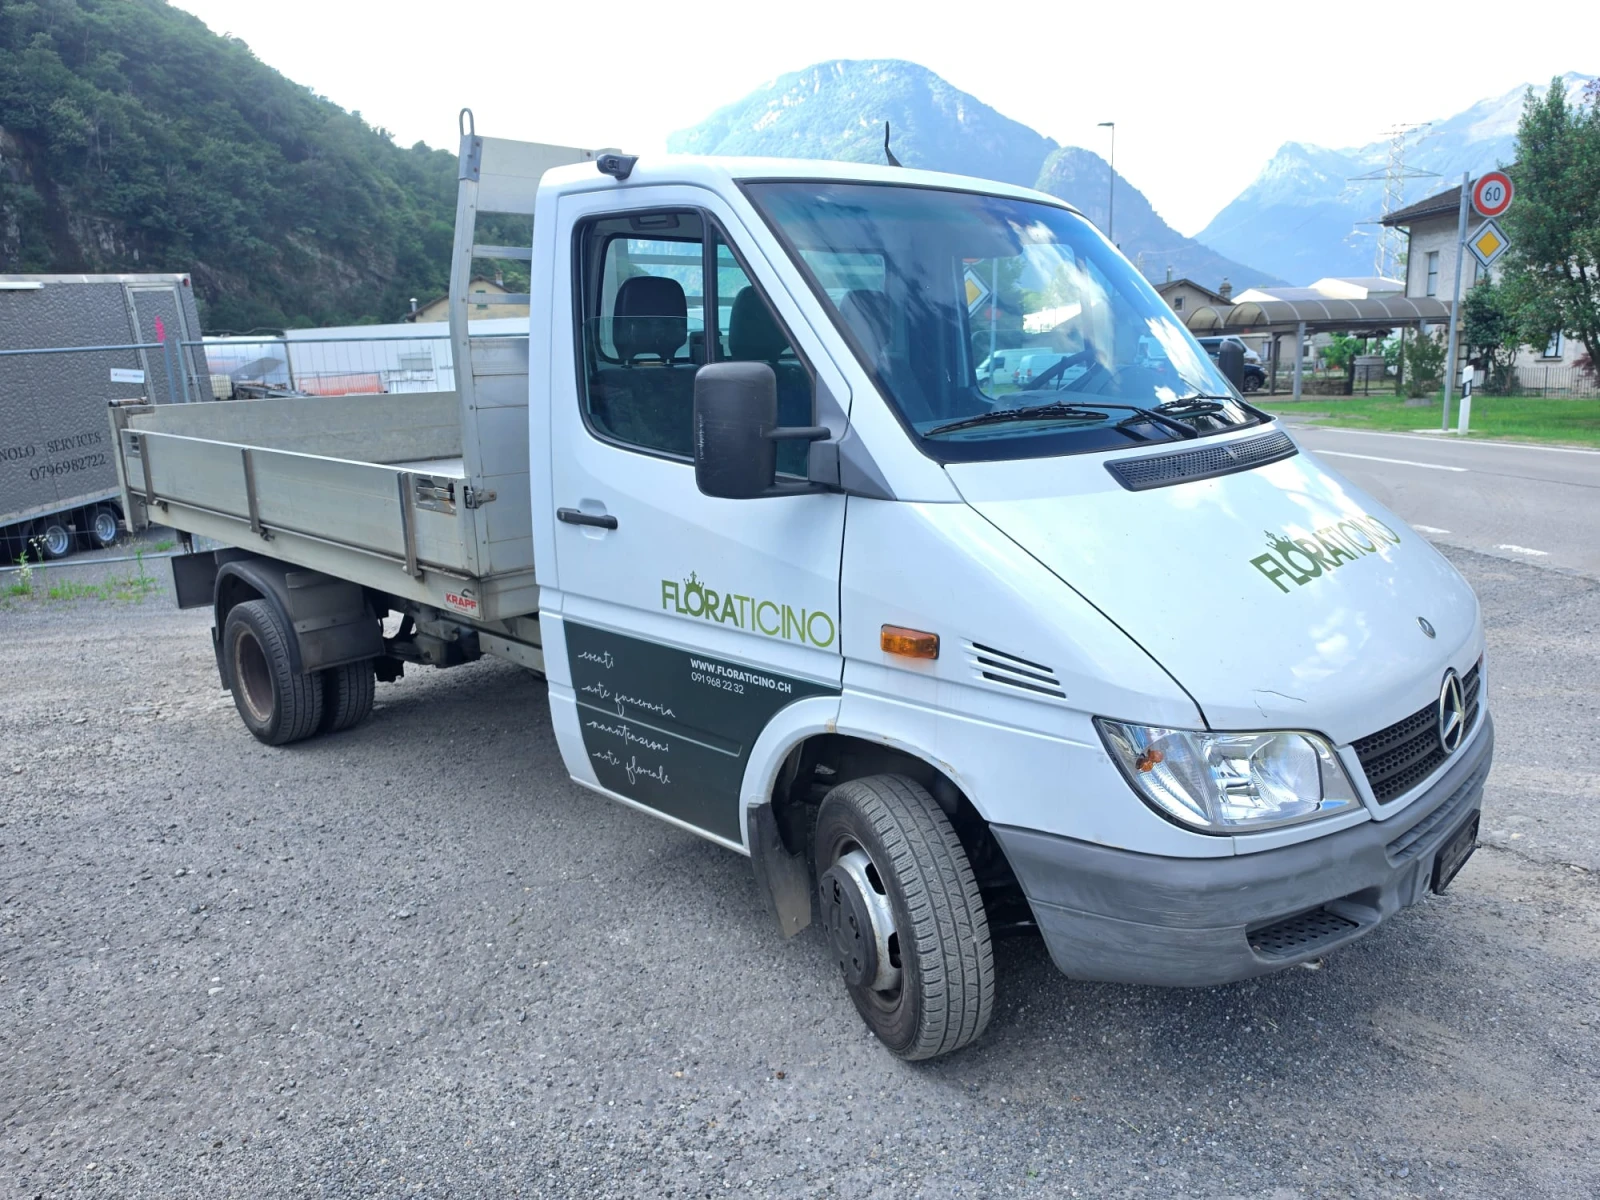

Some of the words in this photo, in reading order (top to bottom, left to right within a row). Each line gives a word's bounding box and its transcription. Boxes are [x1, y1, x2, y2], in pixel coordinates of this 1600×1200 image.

[1485, 187, 1501, 202] 60
[47, 432, 102, 454] SERVICES
[29, 453, 106, 481] 0796982722
[1249, 515, 1401, 594] FLORATICINO
[445, 592, 477, 610] KRAPF
[661, 579, 835, 648] FLORATICINO
[578, 650, 614, 669] eventi
[690, 658, 792, 694] WWW.FLORATICINO.CH
[691, 671, 705, 684] 091
[705, 675, 721, 688] 968
[722, 680, 732, 691] 22
[733, 683, 744, 694] 32
[581, 681, 610, 699] arte
[614, 692, 676, 718] funeraria
[592, 749, 620, 766] arte
